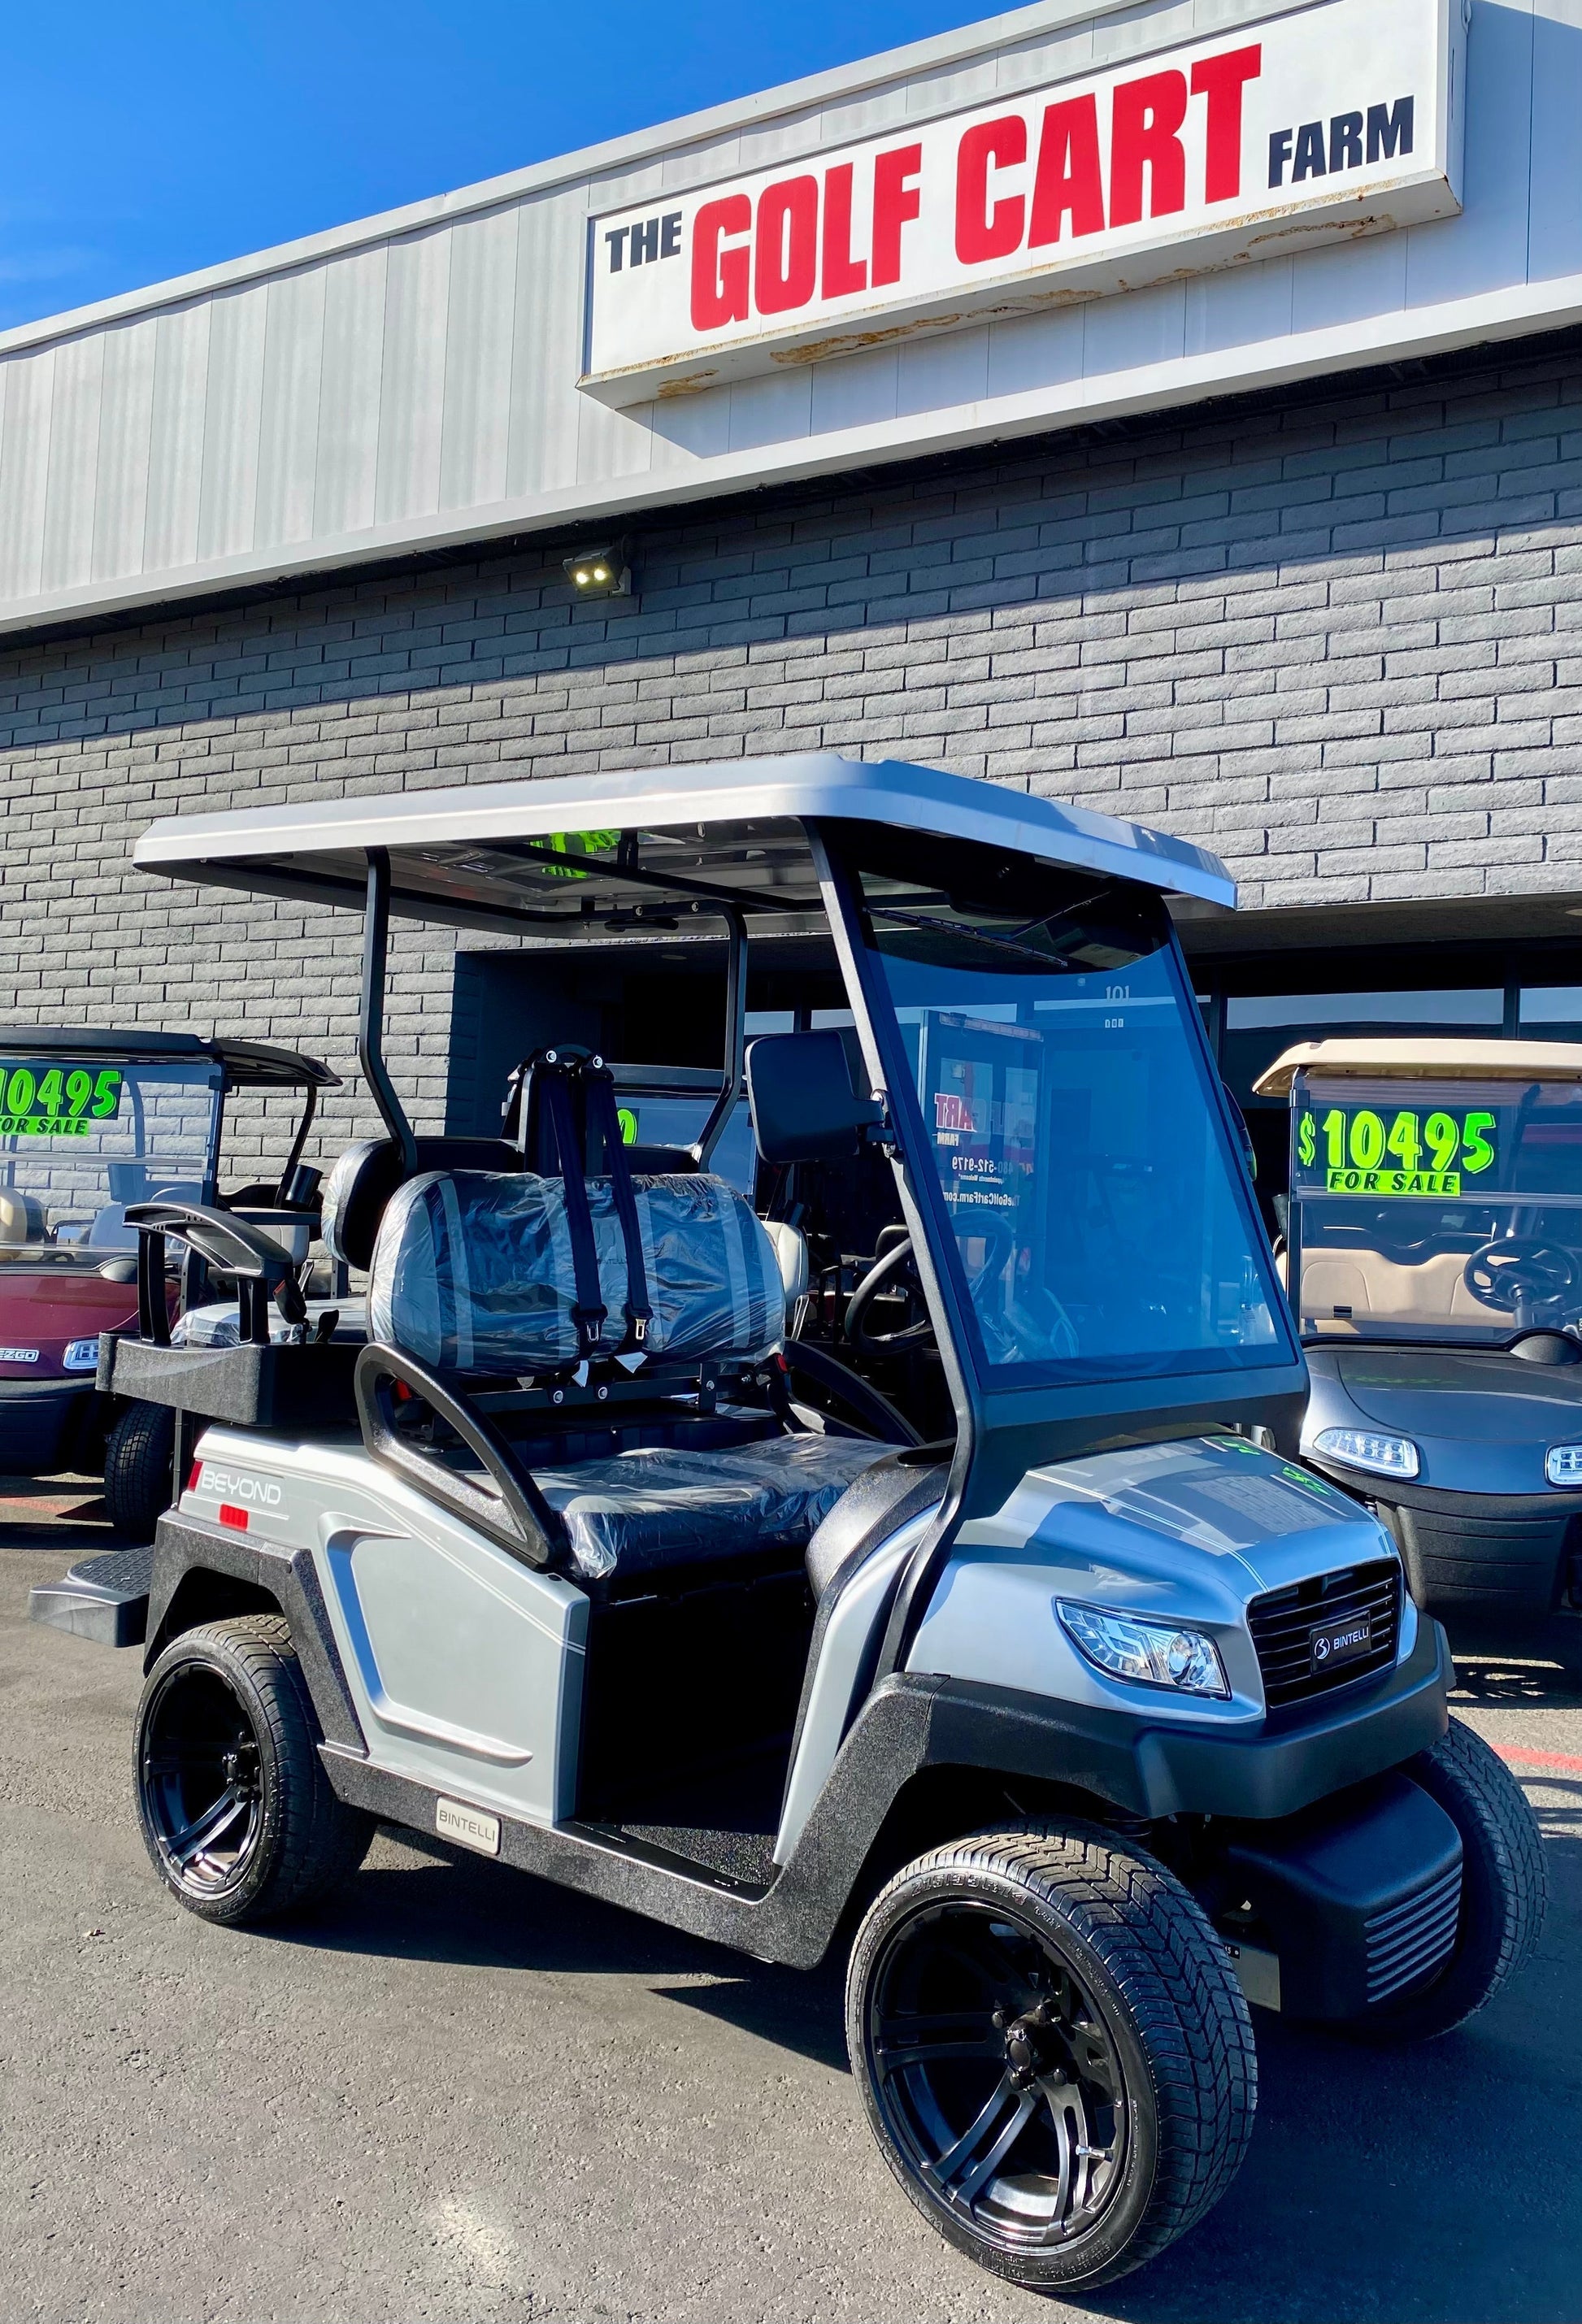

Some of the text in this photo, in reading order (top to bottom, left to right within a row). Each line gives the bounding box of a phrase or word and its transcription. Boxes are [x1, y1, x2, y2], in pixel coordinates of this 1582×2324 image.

[605, 44, 1415, 332] THE GOLF CART FARM
[0, 1117, 88, 1135] OR SALE
[1298, 1110, 1496, 1174] $10495
[1329, 1171, 1457, 1193] FOR SALE
[201, 1470, 281, 1505] BEYOND
[1333, 1627, 1369, 1650] BINTELLI
[439, 1809, 495, 1843] BINTELLI
